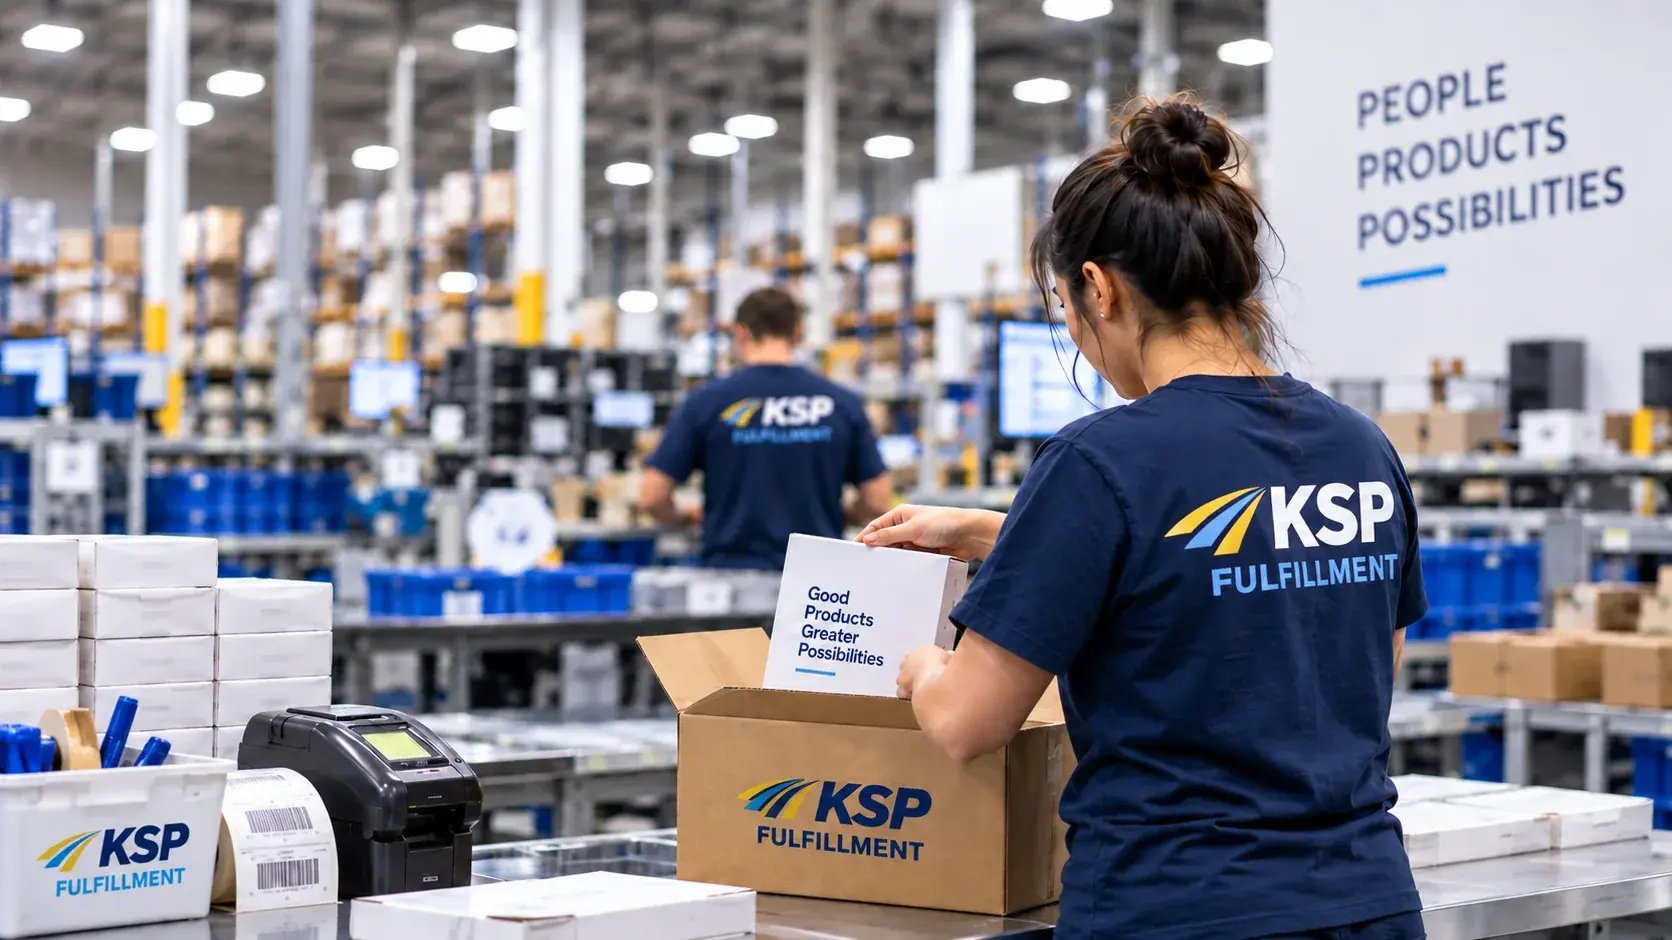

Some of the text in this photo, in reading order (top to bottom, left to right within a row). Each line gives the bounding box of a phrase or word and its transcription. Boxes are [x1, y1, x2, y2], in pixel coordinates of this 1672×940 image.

[1358, 62, 1507, 129] PEOPLE
[1358, 114, 1567, 190] PRODUCTS
[1358, 166, 1626, 250] POSSIBILITIES
[761, 395, 834, 427] KSP
[1270, 481, 1395, 550] KSP
[1211, 553, 1398, 597] FULFILLMENT
[804, 604, 874, 627] Products
[808, 586, 850, 605] Good
[801, 623, 860, 645] Greater
[798, 642, 884, 667] Possibilities
[815, 780, 932, 830] KSP
[98, 822, 190, 868] KSP
[757, 825, 925, 862] FULFILLMENT
[56, 866, 185, 897] FULFILLMENT
